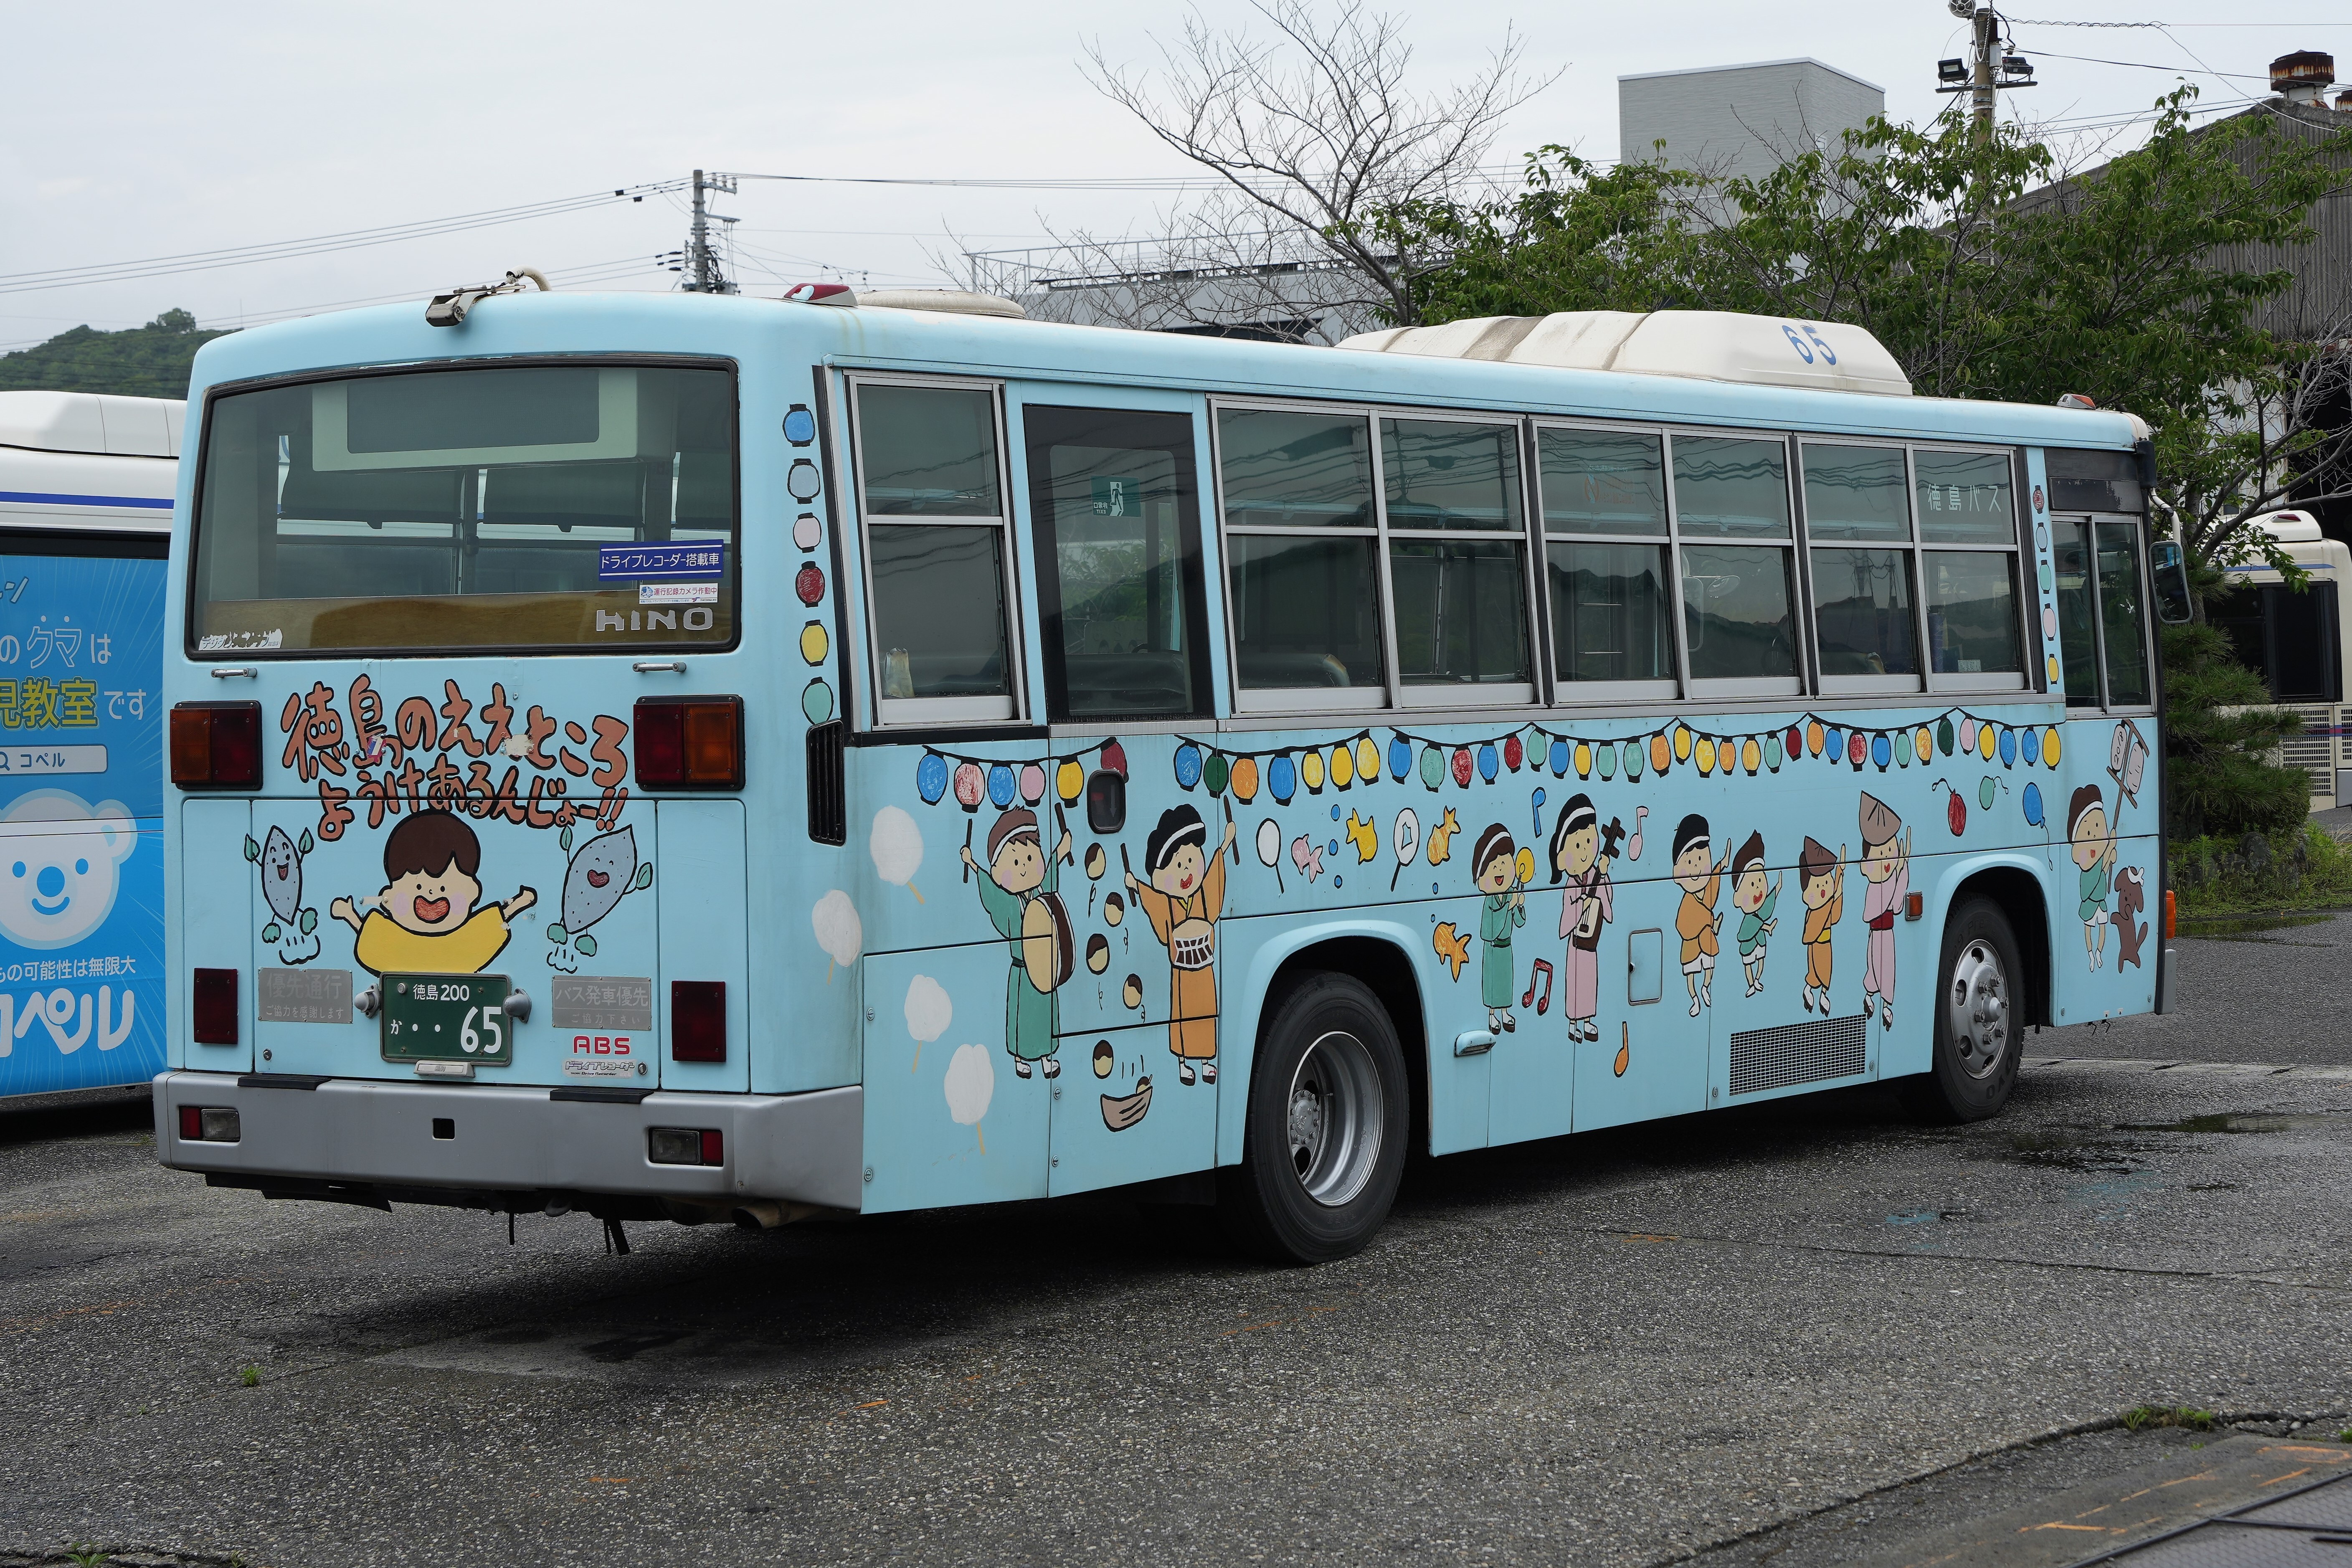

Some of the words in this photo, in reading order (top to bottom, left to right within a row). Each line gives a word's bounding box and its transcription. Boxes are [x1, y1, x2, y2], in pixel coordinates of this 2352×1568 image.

[1782, 325, 1836, 365] 65
[1927, 483, 2001, 512] 徳島バス
[601, 552, 720, 568] ドライブレコーダー搭載車
[0, 576, 29, 604] ン
[654, 587, 717, 595] 運行記録カメラ作動中
[596, 607, 713, 631] HINO
[281, 673, 629, 788] 徳島のええところ
[20, 752, 65, 768] コペル
[266, 973, 342, 1000] 優先通行
[555, 985, 648, 1007] バス発車優先
[266, 1005, 344, 1019] ご協力を感謝します
[572, 1013, 640, 1025] ご協力下さい
[573, 1036, 630, 1055] ABS
[565, 1061, 635, 1071] ドライブレコーダー
